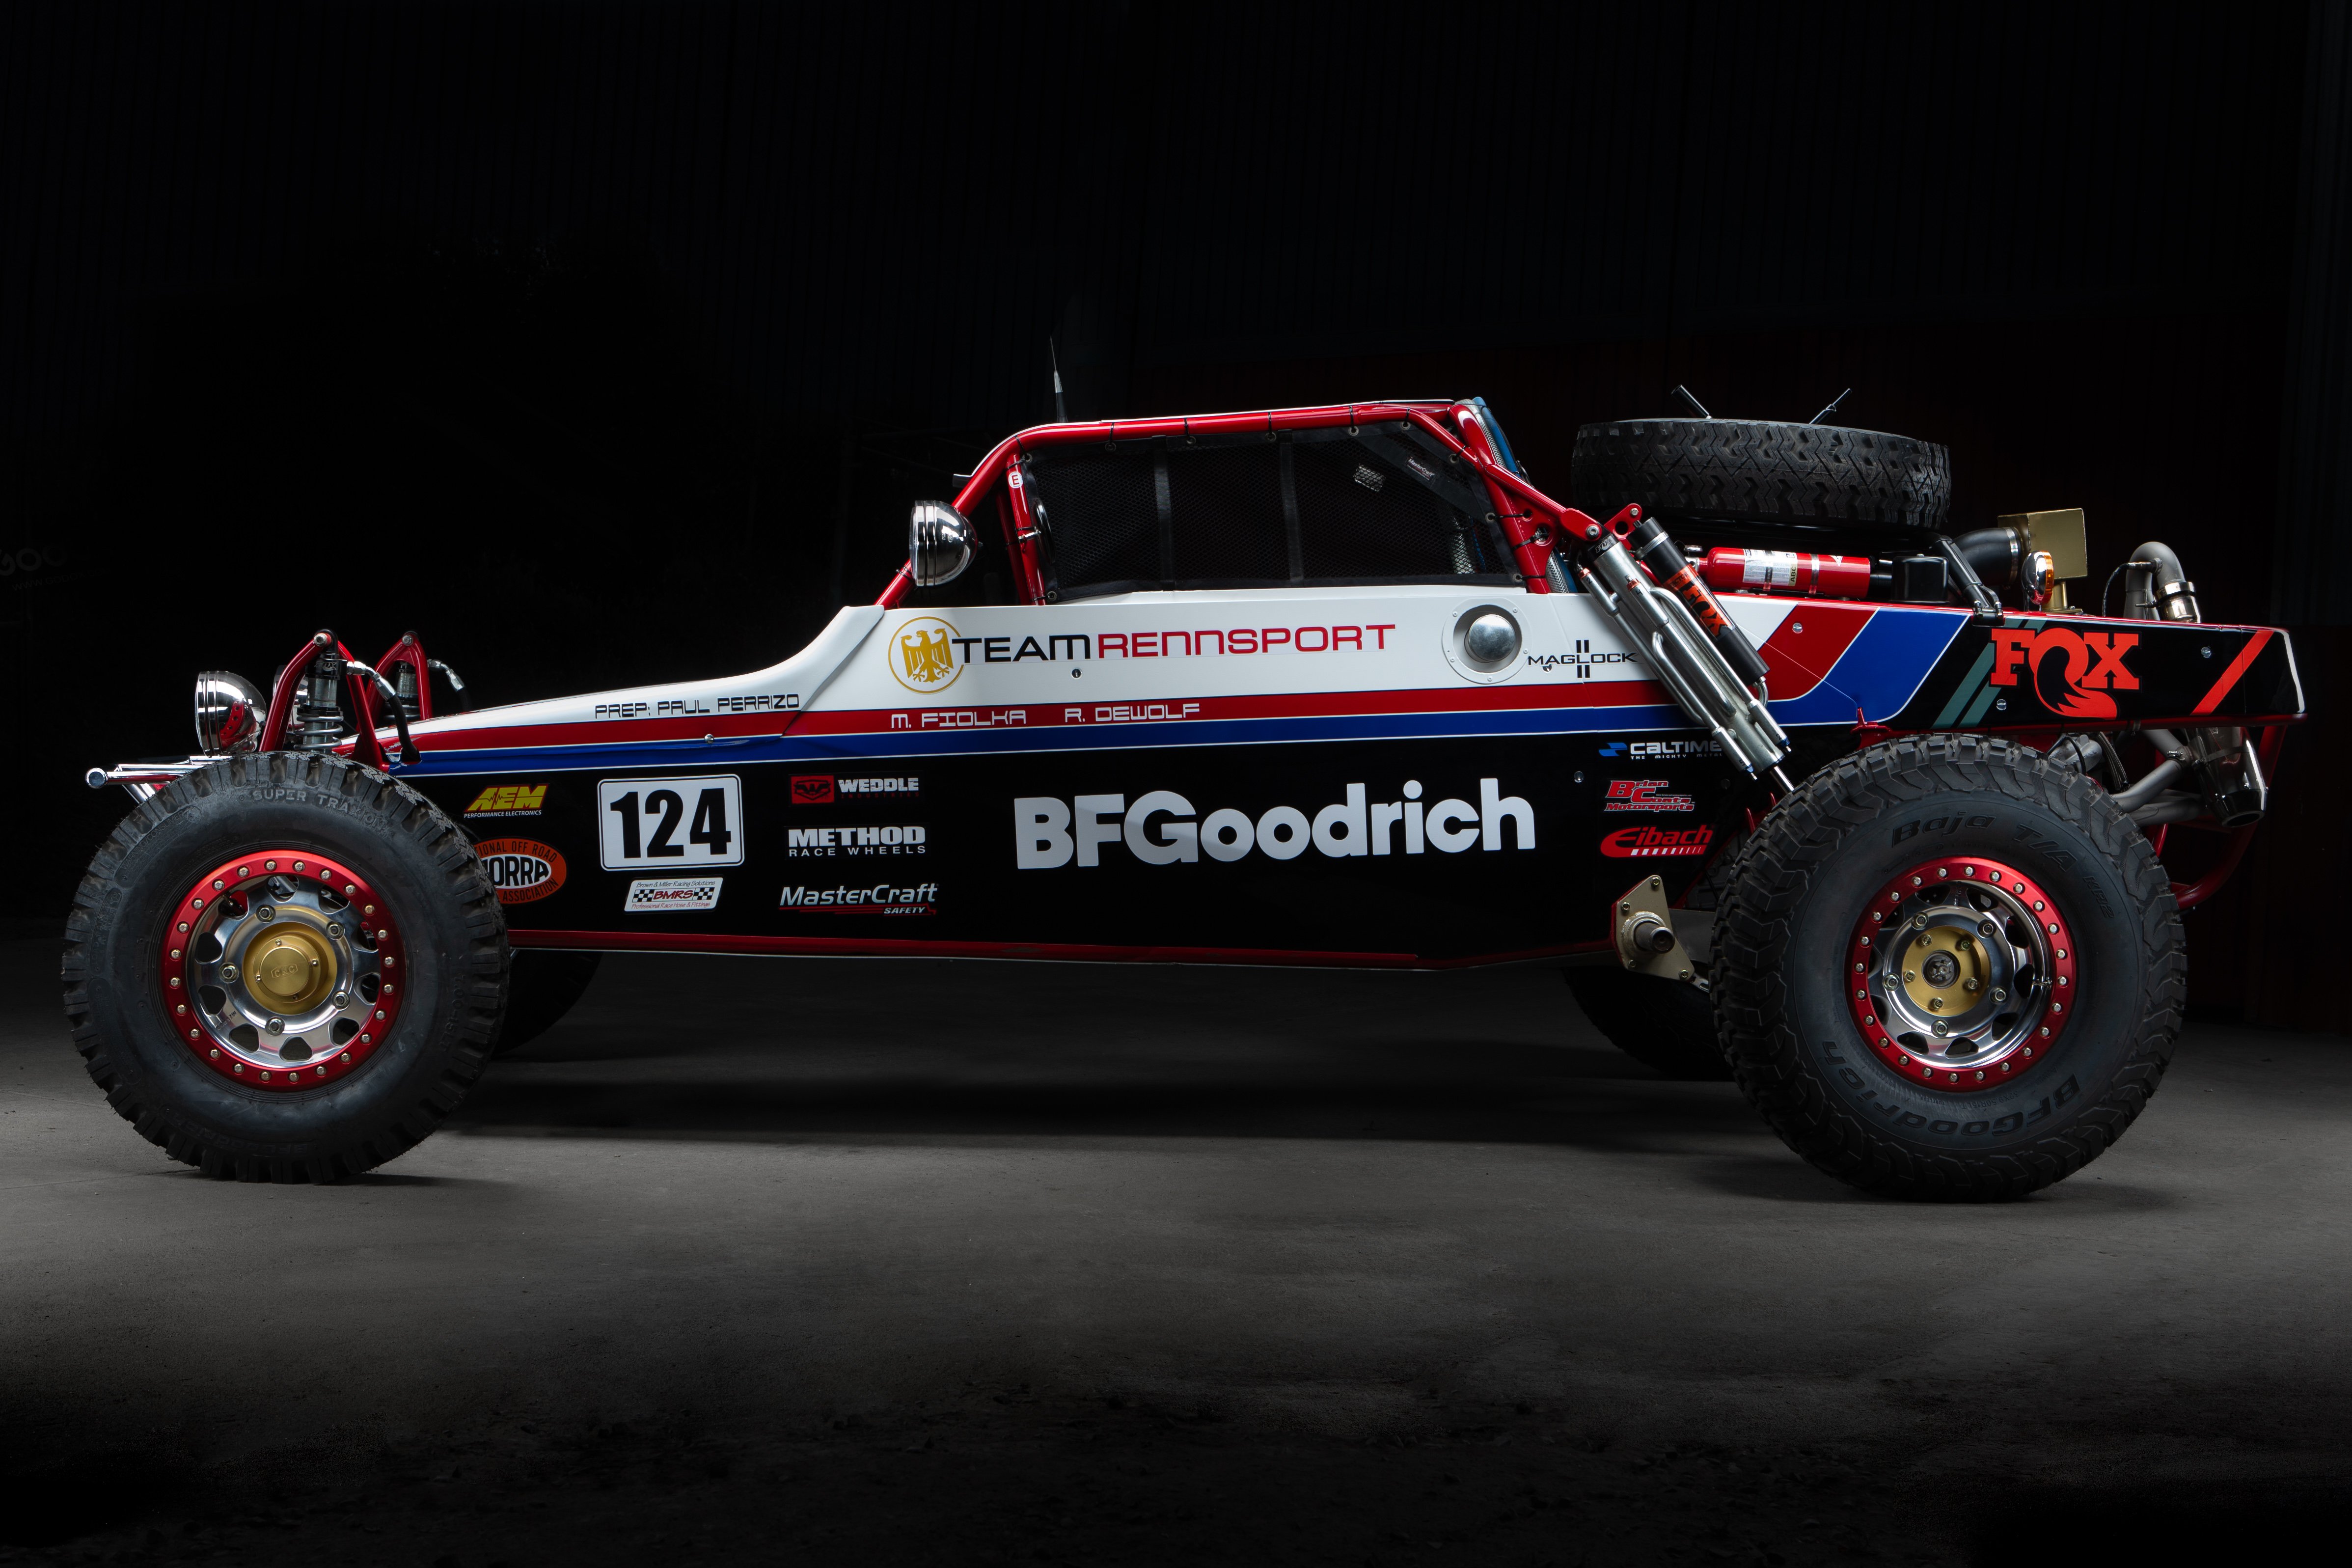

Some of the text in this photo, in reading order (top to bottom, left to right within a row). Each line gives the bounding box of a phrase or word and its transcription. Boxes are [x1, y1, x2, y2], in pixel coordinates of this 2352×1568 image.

[1012, 474, 1020, 486] E
[1683, 584, 1728, 636] FOX
[952, 624, 1395, 663] TEAM RENNSPORT
[1528, 652, 1639, 666] MAGLOCK
[1990, 627, 2140, 719] FOX
[596, 694, 799, 718] PREP: PAUL PERRIZO
[1065, 703, 1201, 724] R. DEWOLF
[891, 710, 1027, 729] M. FIOLKA
[252, 789, 308, 802] SUPER
[838, 777, 919, 793] WEDDLE
[1605, 779, 1668, 798] Brian
[1631, 787, 1692, 804] Coats
[467, 785, 548, 811] AEM
[1604, 802, 1695, 812] Motorsports
[610, 788, 731, 858] 124
[1013, 777, 1535, 870] BFGoodrich
[788, 826, 926, 848] METHOD
[1599, 824, 1714, 858] Eibach
[475, 840, 557, 863] IONAL OFF ROAD
[789, 845, 926, 857] RACE WHEELS
[1891, 811, 1995, 848] Baja
[2015, 824, 2078, 873] T/A
[2083, 876, 2115, 919] KR2
[502, 877, 559, 902] ASSOCIATION
[653, 890, 694, 900] BMRS
[779, 882, 938, 906] MasterCraft
[274, 965, 296, 978] CNC
[1821, 1039, 2083, 1140] BFGoodrich
